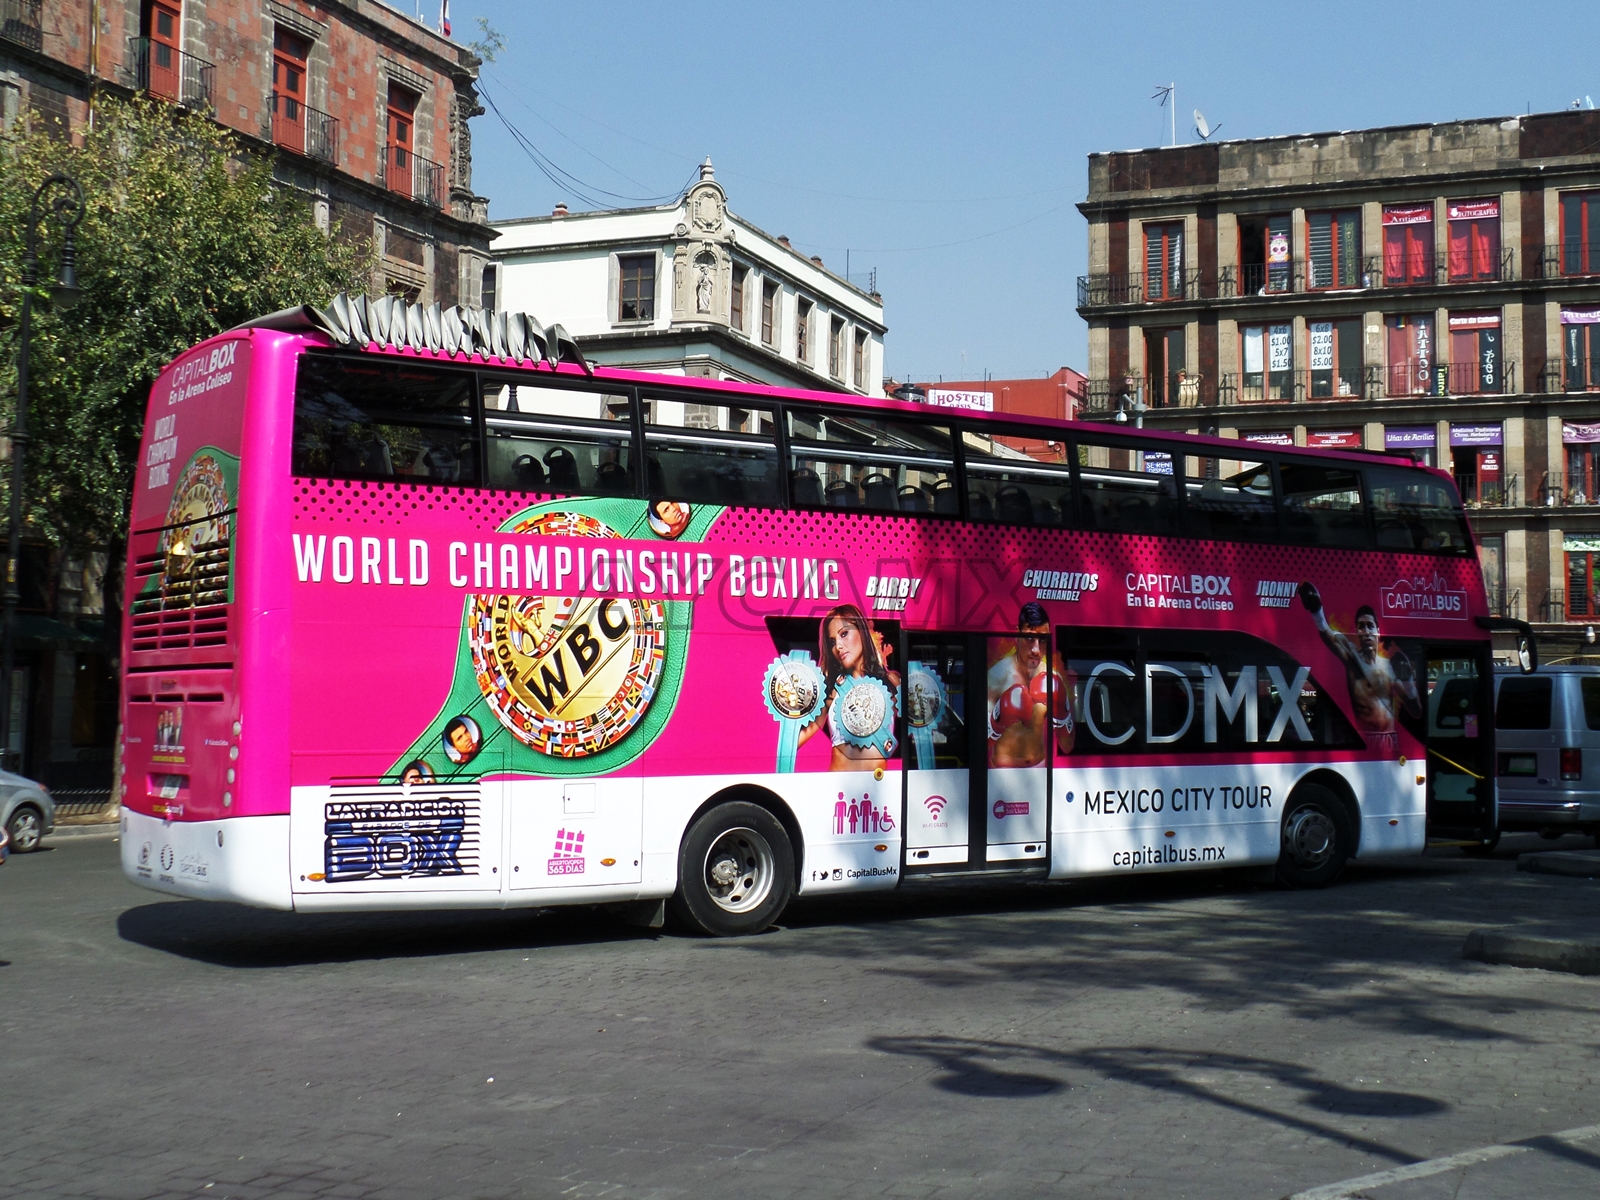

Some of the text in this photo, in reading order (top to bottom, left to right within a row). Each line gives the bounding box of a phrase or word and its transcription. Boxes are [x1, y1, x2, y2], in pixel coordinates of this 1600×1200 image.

[1390, 214, 1427, 223] Antigua
[1273, 325, 1288, 334] 4x6
[1315, 323, 1330, 333] 6x8
[1271, 336, 1291, 346] $1.00
[1312, 335, 1333, 344] $2.00
[1275, 347, 1288, 356] 5x7
[1313, 346, 1332, 355] 8x10
[1272, 358, 1292, 368] $1.50
[1312, 356, 1333, 366] $5.00
[185, 381, 206, 400] Arena
[206, 371, 232, 392] Coliseo
[937, 393, 986, 406] HOSTEL
[1403, 433, 1411, 441] de
[1155, 461, 1173, 469] RENT
[292, 533, 840, 601] WORLD CHAMPIONSHIP BOXING
[1022, 569, 1099, 592] CHURRITOS
[1125, 572, 1233, 596] CAPITALBOX
[865, 576, 921, 599] BARBY
[1256, 580, 1299, 598] JHONNY
[1036, 589, 1081, 602] HERNANDEZ
[1126, 593, 1234, 611] En la Arena Coliseo
[1386, 592, 1461, 612] CAPITALBUS
[872, 597, 907, 612] JUAREZ
[1260, 597, 1291, 608] GONZALEZ
[495, 595, 520, 683] WORLD
[524, 597, 631, 715] WBC
[1083, 662, 1314, 746] CDMX
[1084, 785, 1273, 816] MEXICO CITY TOUR
[1112, 844, 1226, 869] capitalbus.mx
[548, 865, 565, 875] 365
[847, 866, 898, 880] CapitalBusMx
